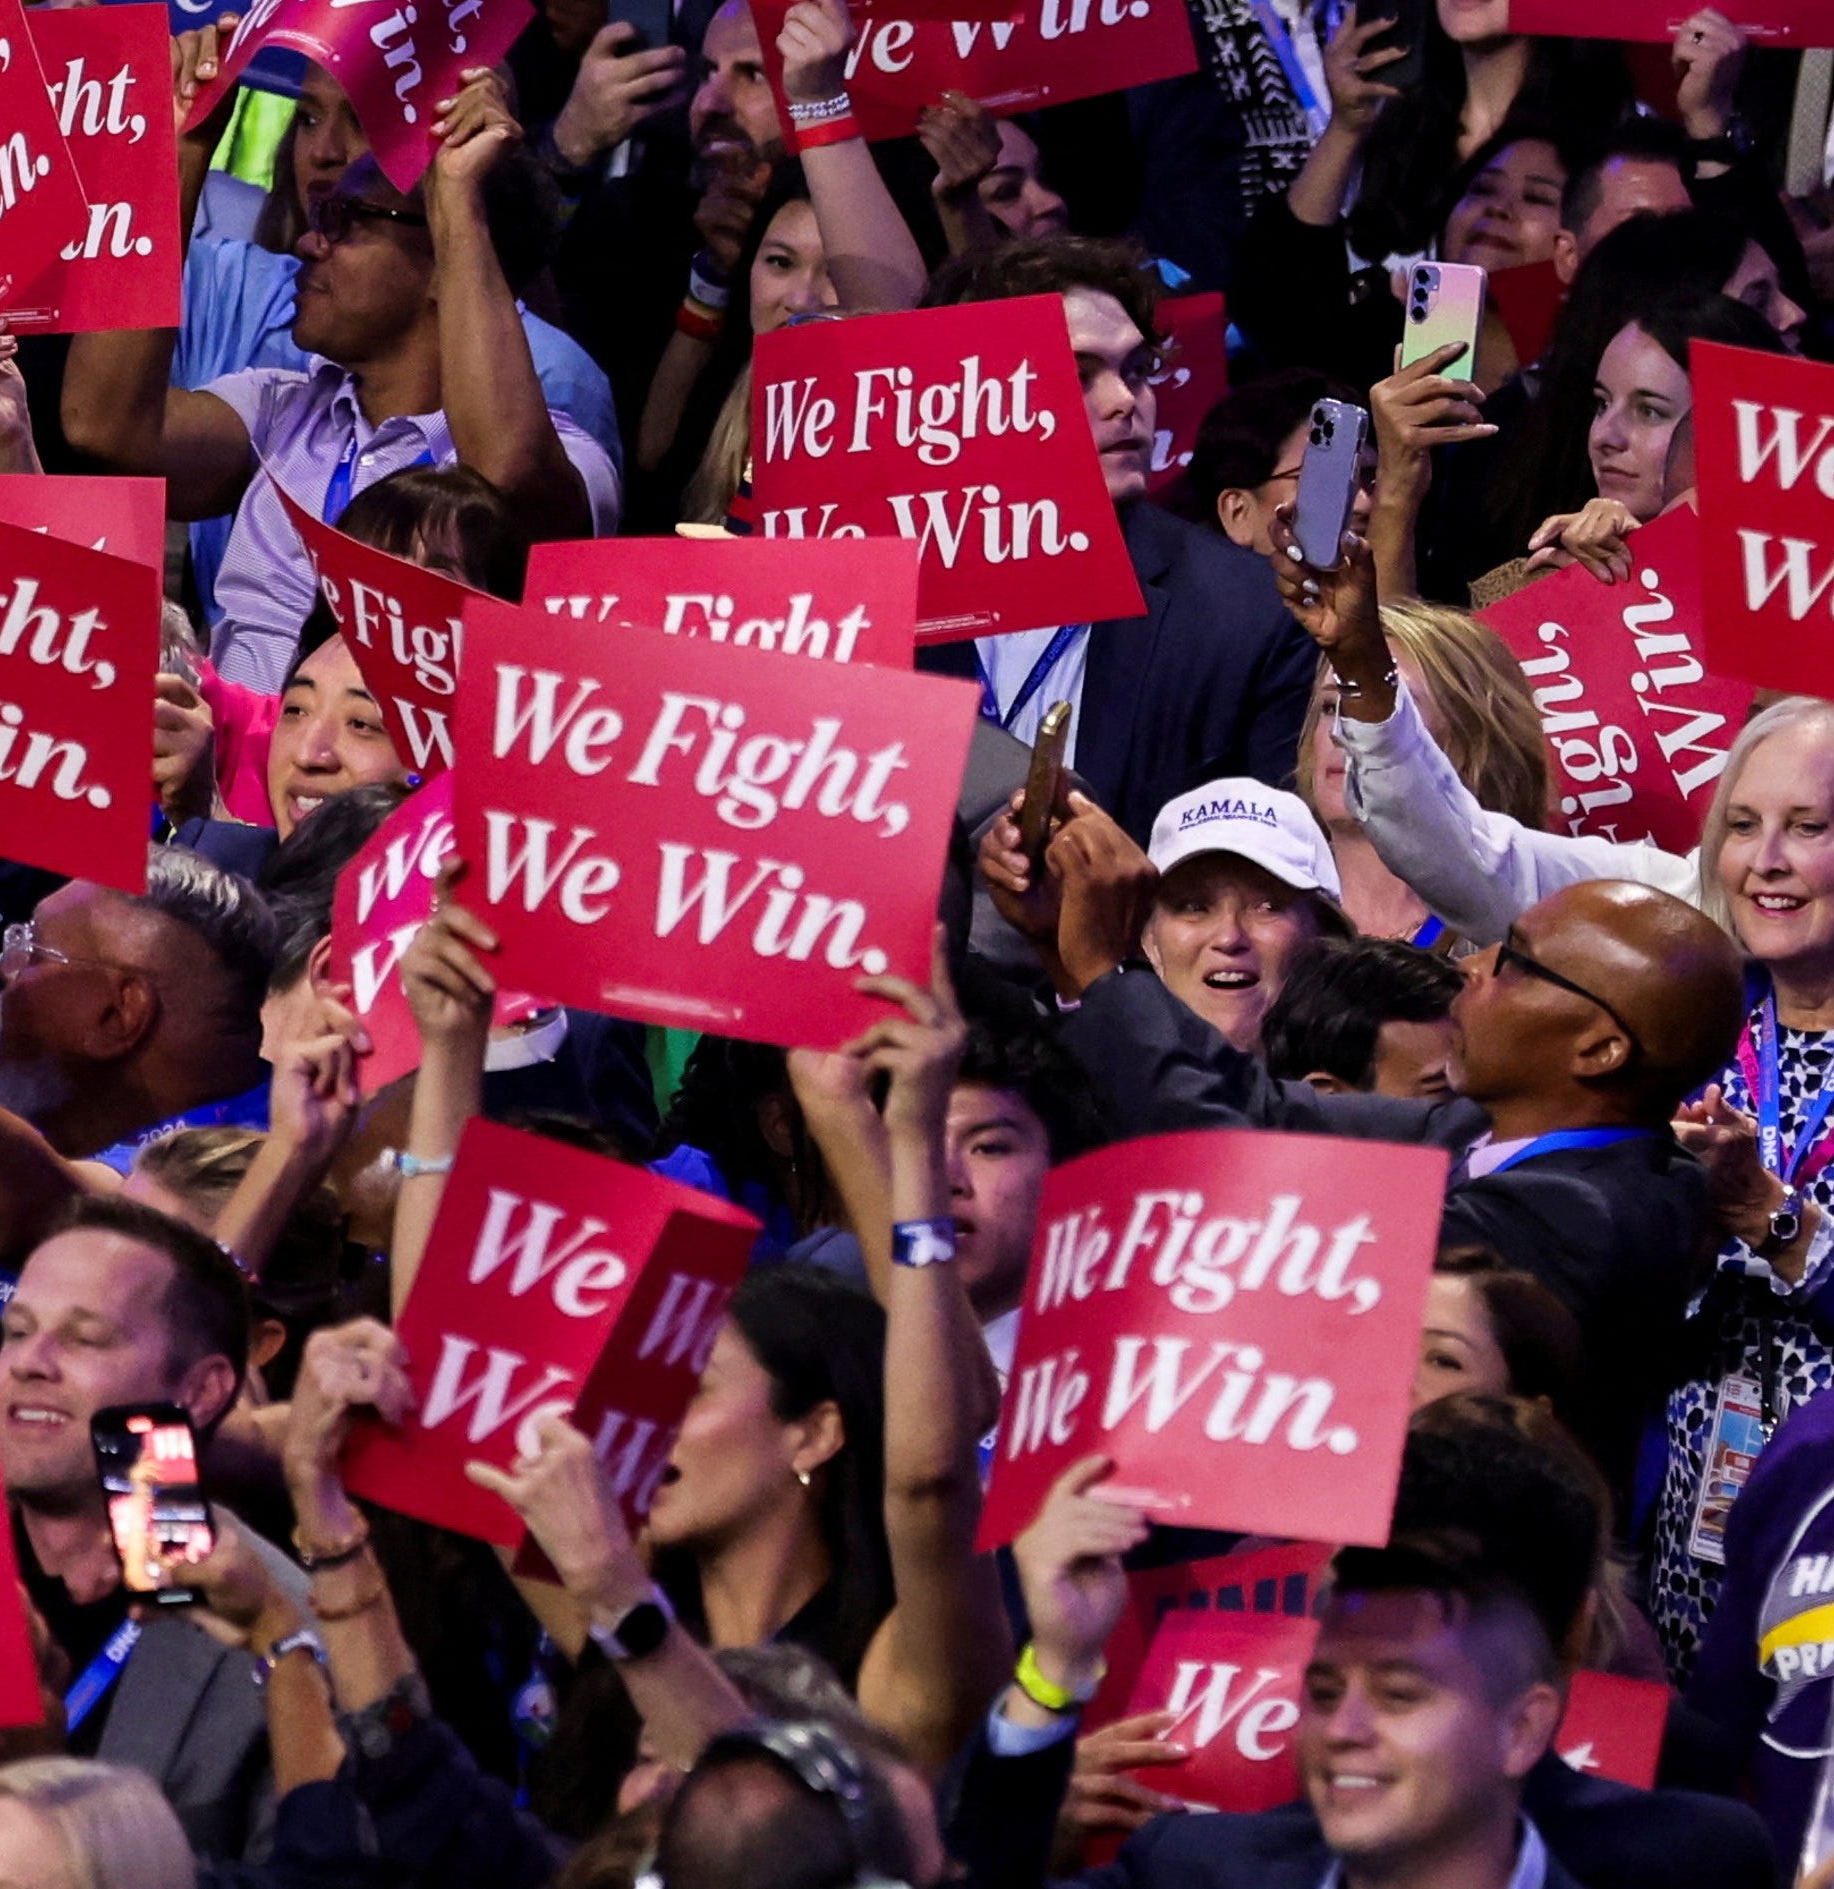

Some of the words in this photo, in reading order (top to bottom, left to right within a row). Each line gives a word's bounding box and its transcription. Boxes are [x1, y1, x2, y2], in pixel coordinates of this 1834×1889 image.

[766, 378, 835, 463] We
[848, 356, 1055, 465] Fight,
[887, 485, 1089, 568] Win.
[495, 665, 623, 774] We
[628, 693, 909, 837] Fight,
[1181, 798, 1277, 825] KAMALA
[486, 811, 620, 923] We
[656, 843, 887, 975] Win.
[1762, 1125, 1778, 1169] DNC
[1038, 1207, 1110, 1312] We
[1108, 1192, 1381, 1314] Fight,
[1009, 1351, 1088, 1459] We
[1104, 1336, 1358, 1454] Win.
